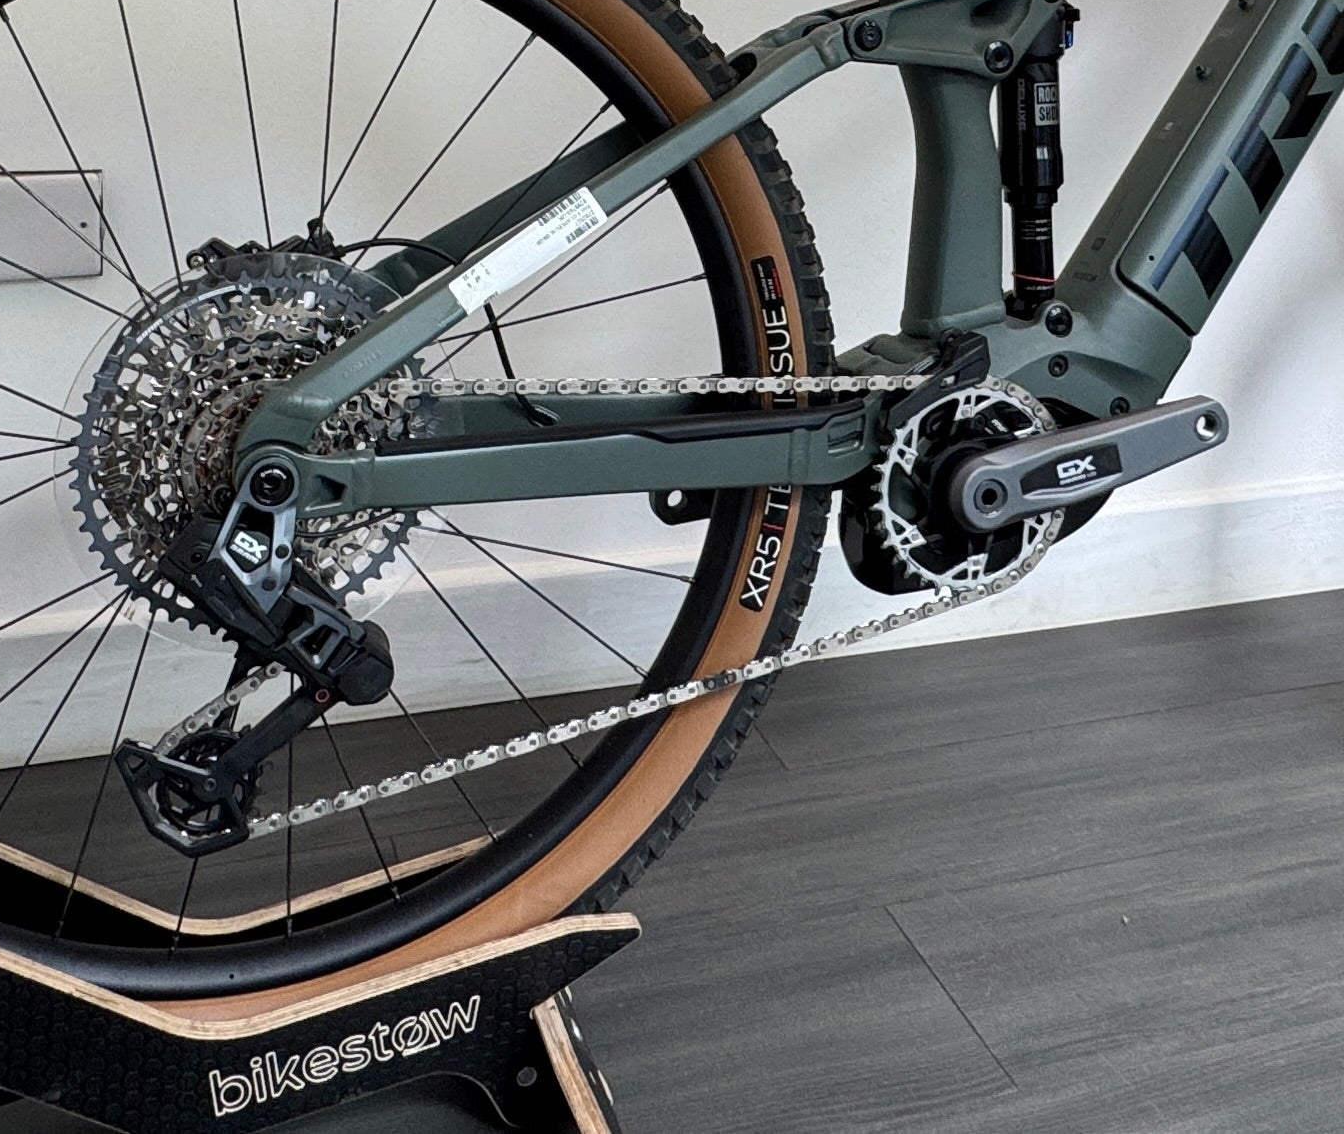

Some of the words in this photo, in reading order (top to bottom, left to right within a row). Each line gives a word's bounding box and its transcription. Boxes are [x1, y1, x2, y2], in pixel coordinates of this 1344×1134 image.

[1038, 86, 1058, 103] ROC
[741, 533, 781, 607] XR5
[762, 306, 796, 403] ISUE
[1057, 455, 1097, 479] GX
